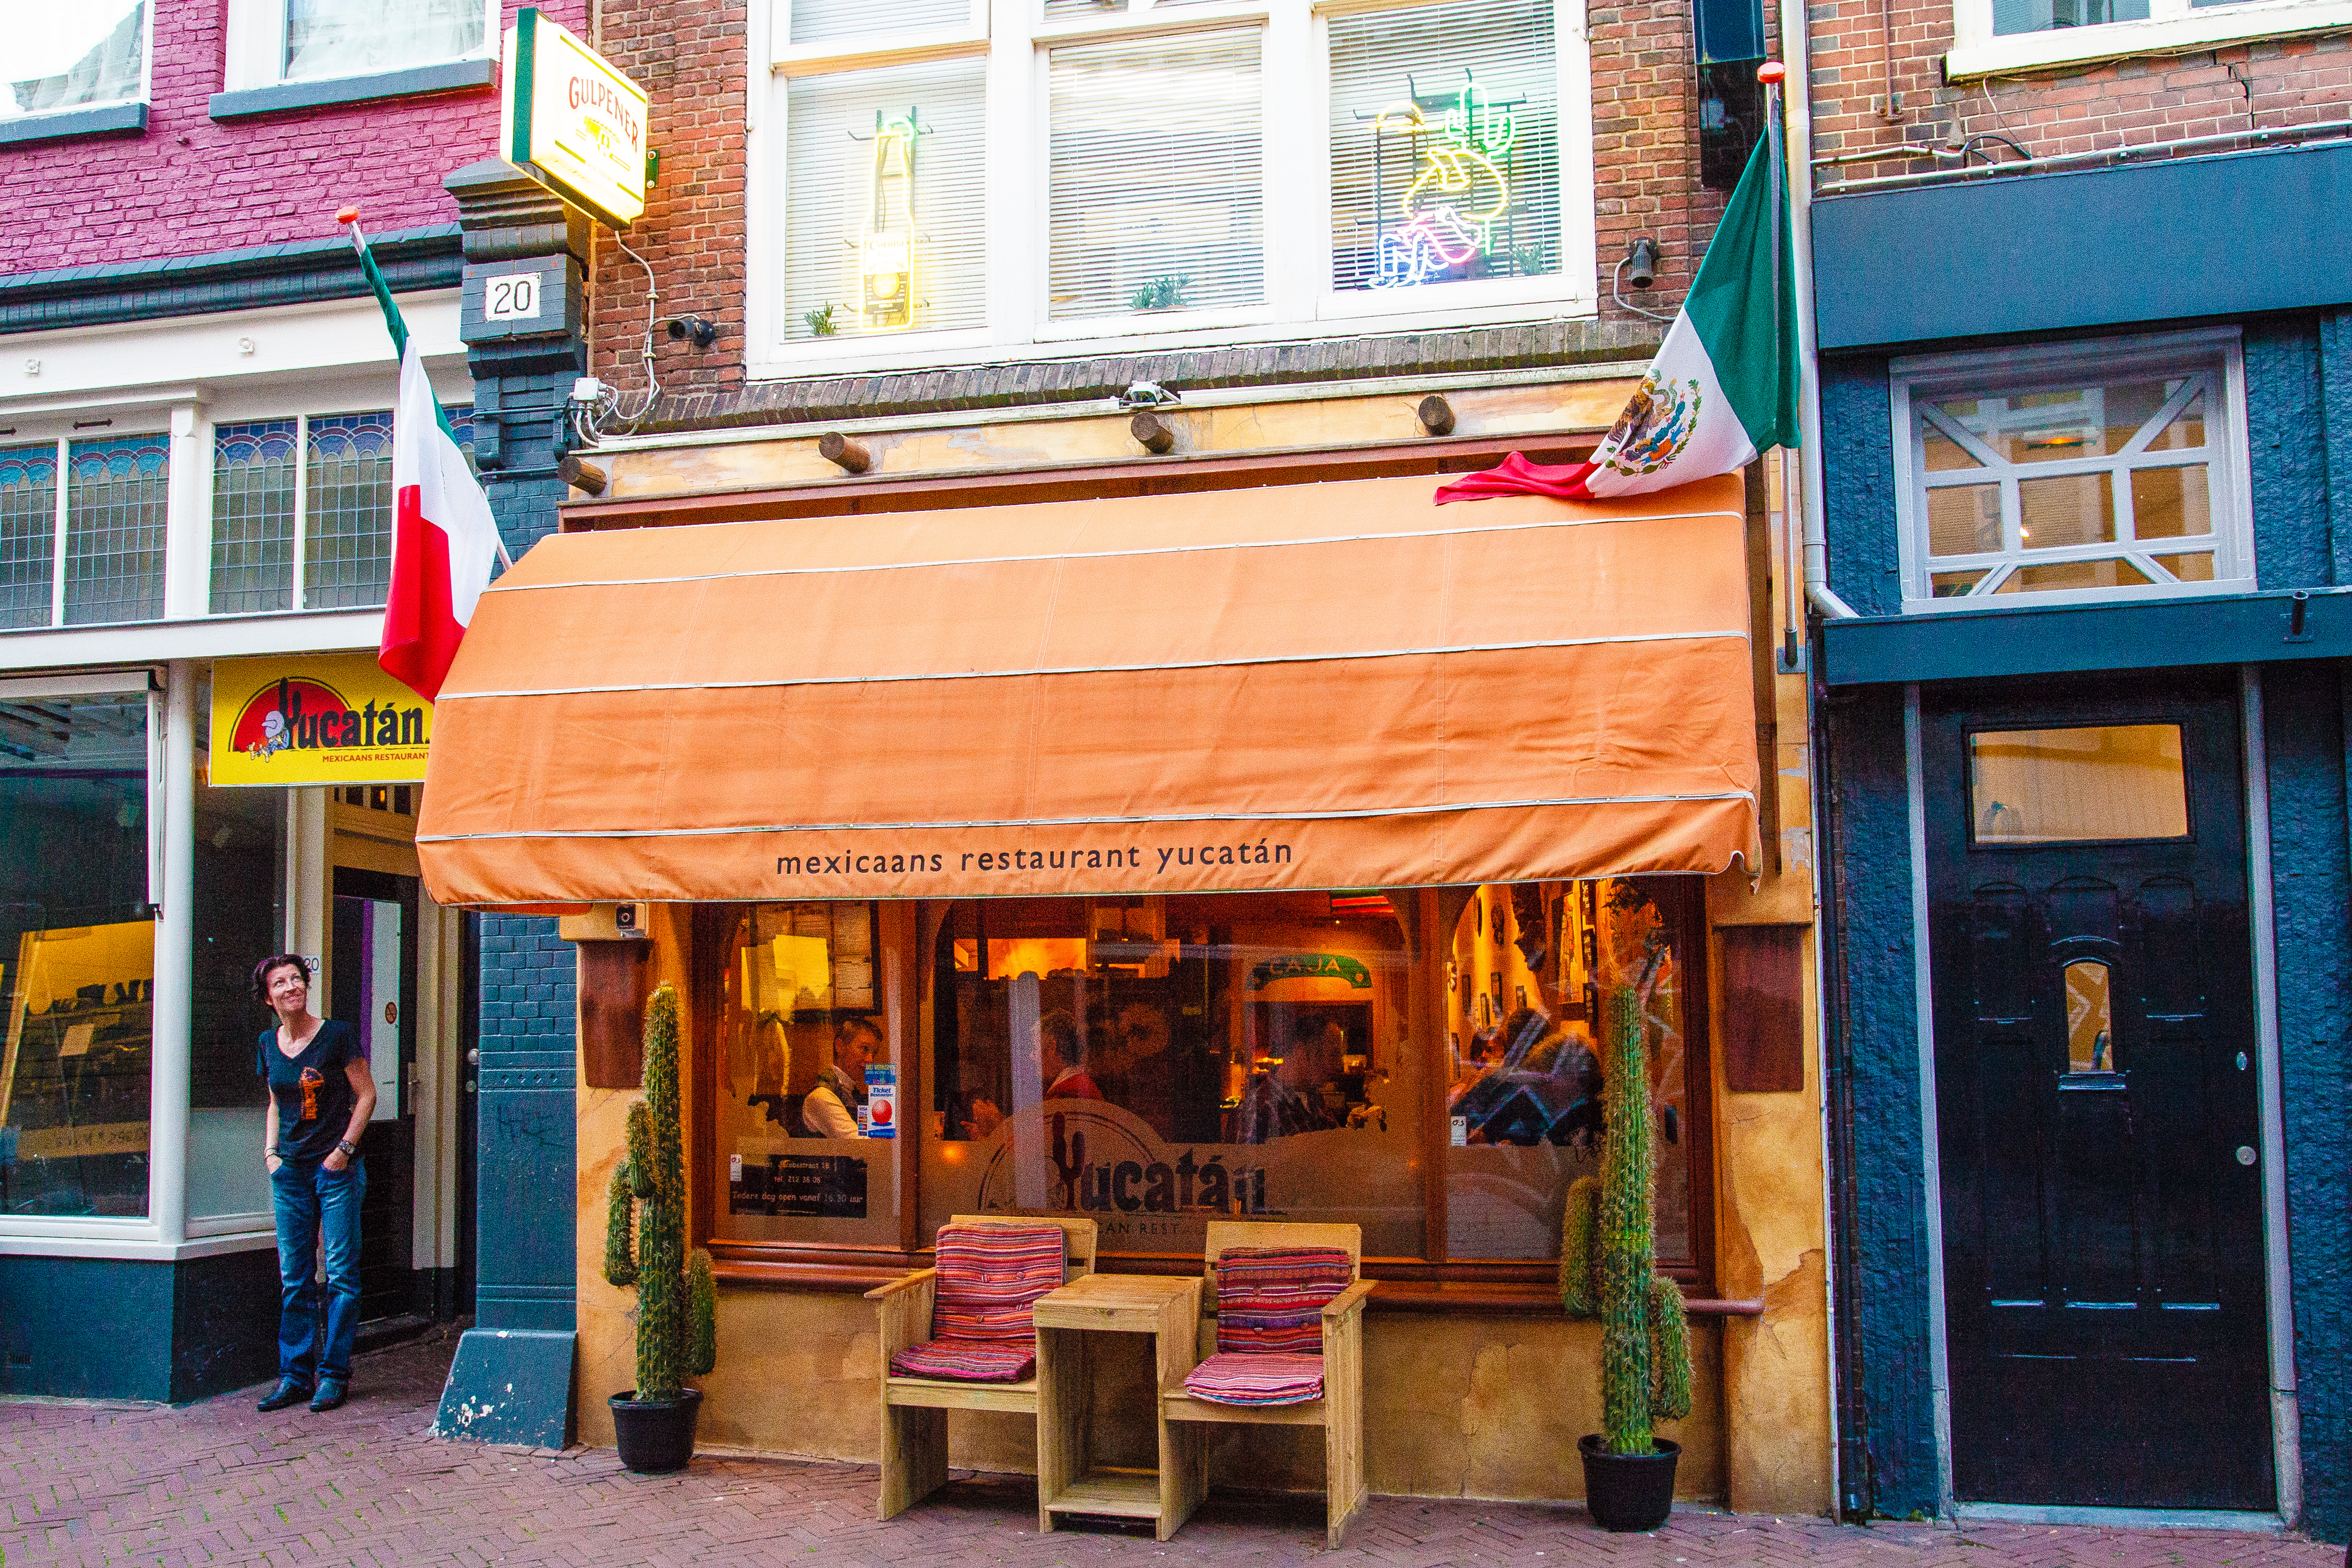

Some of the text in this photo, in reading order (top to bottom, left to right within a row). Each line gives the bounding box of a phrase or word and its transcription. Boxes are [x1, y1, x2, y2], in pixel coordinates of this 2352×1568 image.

[569, 76, 639, 153] GULPENER
[870, 240, 904, 250] Corona
[494, 280, 532, 315] 20
[279, 677, 423, 749] Yucatán
[322, 752, 429, 763] MEXICAANS RESTAURANT
[776, 838, 1292, 875] mexicaans restaurant yucatán
[1269, 957, 1341, 975] CAJA
